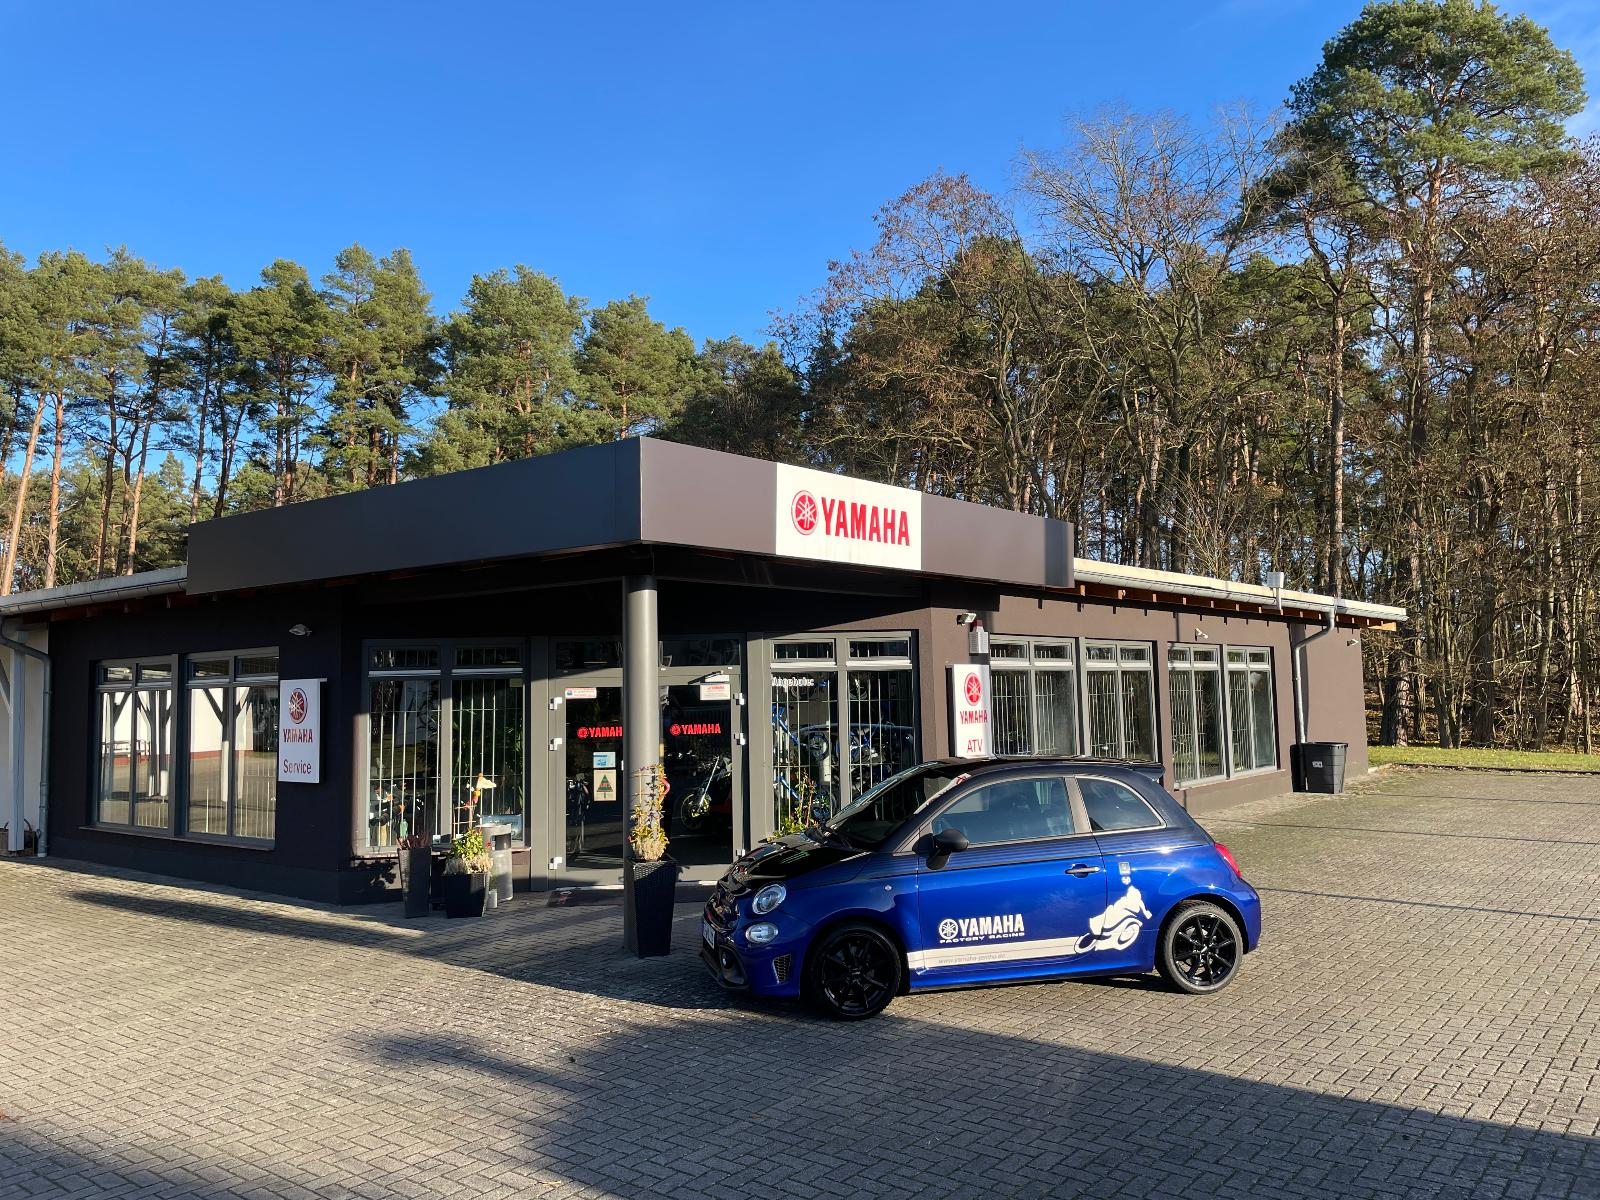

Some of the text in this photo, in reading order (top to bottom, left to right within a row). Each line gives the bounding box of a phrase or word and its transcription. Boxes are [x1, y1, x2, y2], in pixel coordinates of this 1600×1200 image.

[821, 497, 910, 546] YAMAHA
[959, 710, 988, 724] YAMAHA
[283, 728, 313, 743] YAMAHA
[588, 726, 623, 738] YAMAH
[681, 723, 721, 735] YAMAHA
[967, 739, 983, 753] ATV
[283, 758, 312, 775] Service
[958, 914, 1025, 937] YAMAHA
[940, 936, 984, 944] FACTORY
